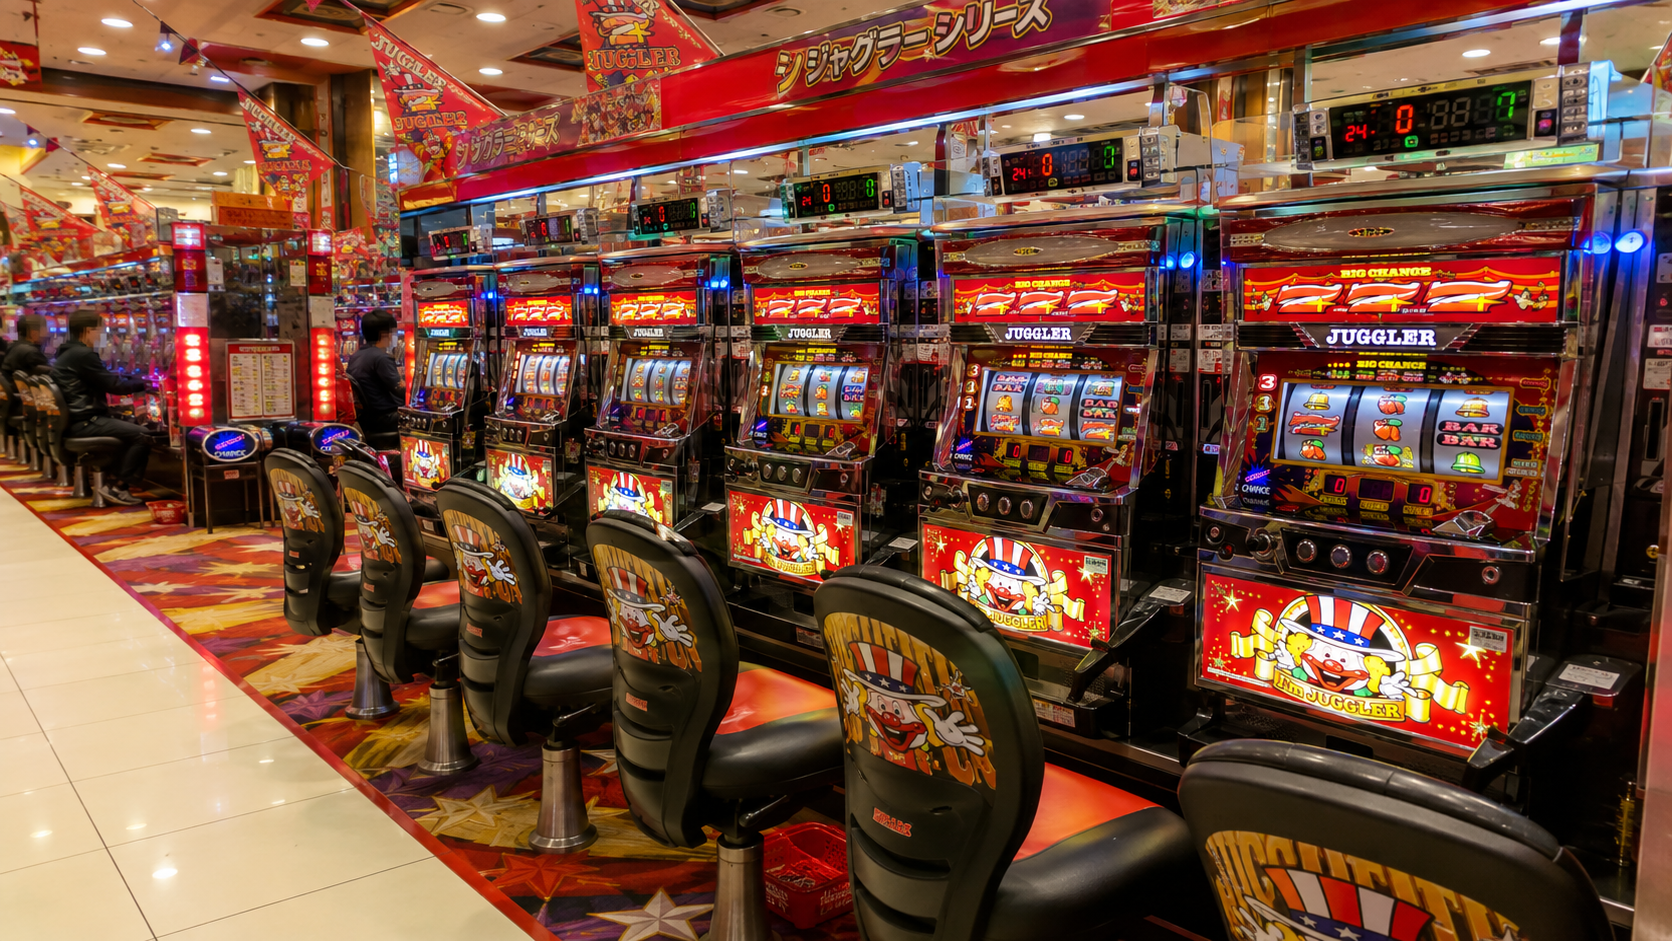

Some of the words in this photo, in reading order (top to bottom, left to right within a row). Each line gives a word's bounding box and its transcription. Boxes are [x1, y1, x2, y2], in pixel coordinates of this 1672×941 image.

[1396, 104, 1414, 134] 0
[1042, 153, 1053, 176] 0
[1104, 146, 1115, 169] 0
[1005, 327, 1072, 341] JUGGLER
[1326, 328, 1437, 346] JUGGLER
[1261, 375, 1275, 389] 3
[1442, 421, 1499, 435] BAR
[1441, 434, 1498, 448] BAR
[1064, 450, 1072, 463] 0
[1334, 478, 1345, 493] 0
[1419, 487, 1432, 503] 0
[1305, 689, 1401, 718] JUGGLER
